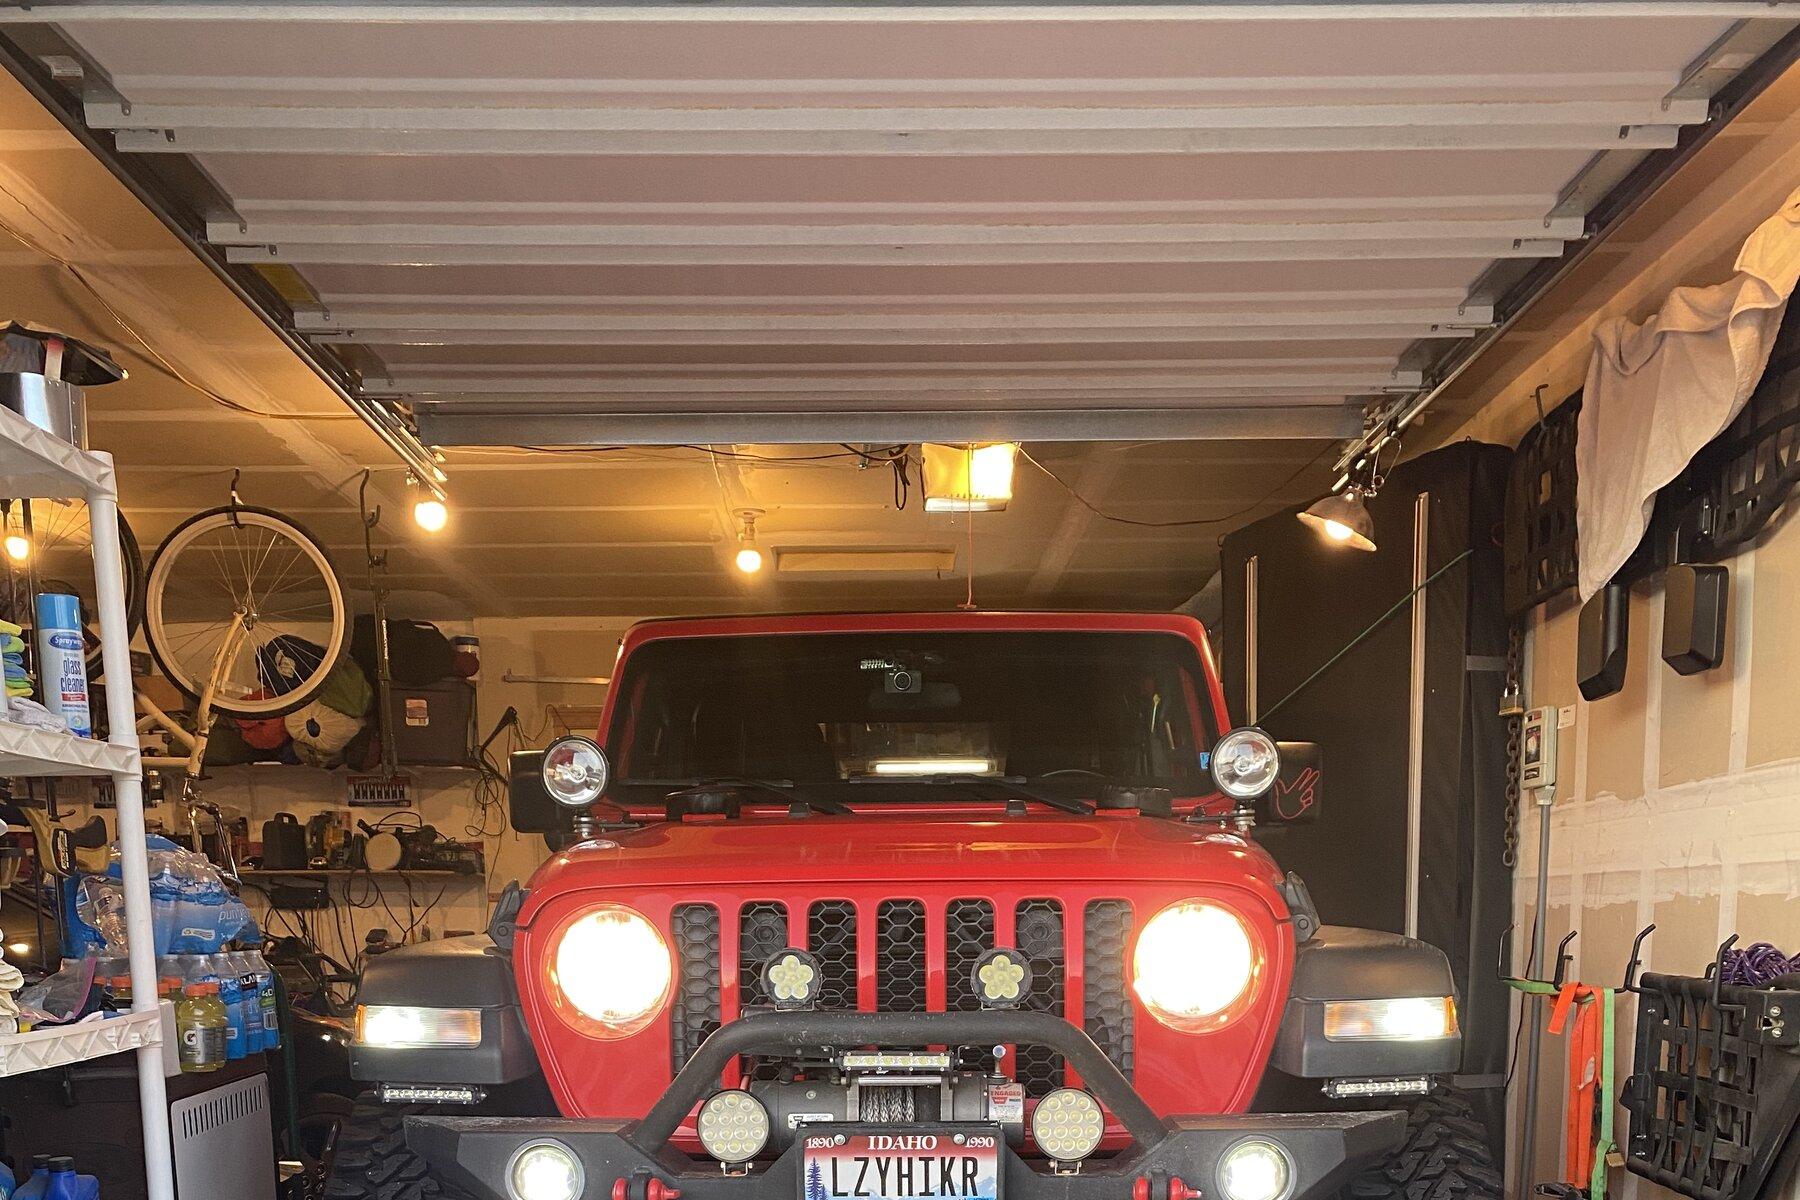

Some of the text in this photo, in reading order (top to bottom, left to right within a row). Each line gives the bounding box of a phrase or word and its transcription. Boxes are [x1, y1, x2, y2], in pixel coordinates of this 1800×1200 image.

[63, 658, 81, 676] glass
[806, 1137, 835, 1149] 1890
[867, 1135, 938, 1150] IDAHO
[964, 1136, 995, 1148] 1990
[831, 1156, 979, 1197] LZYHIKR
